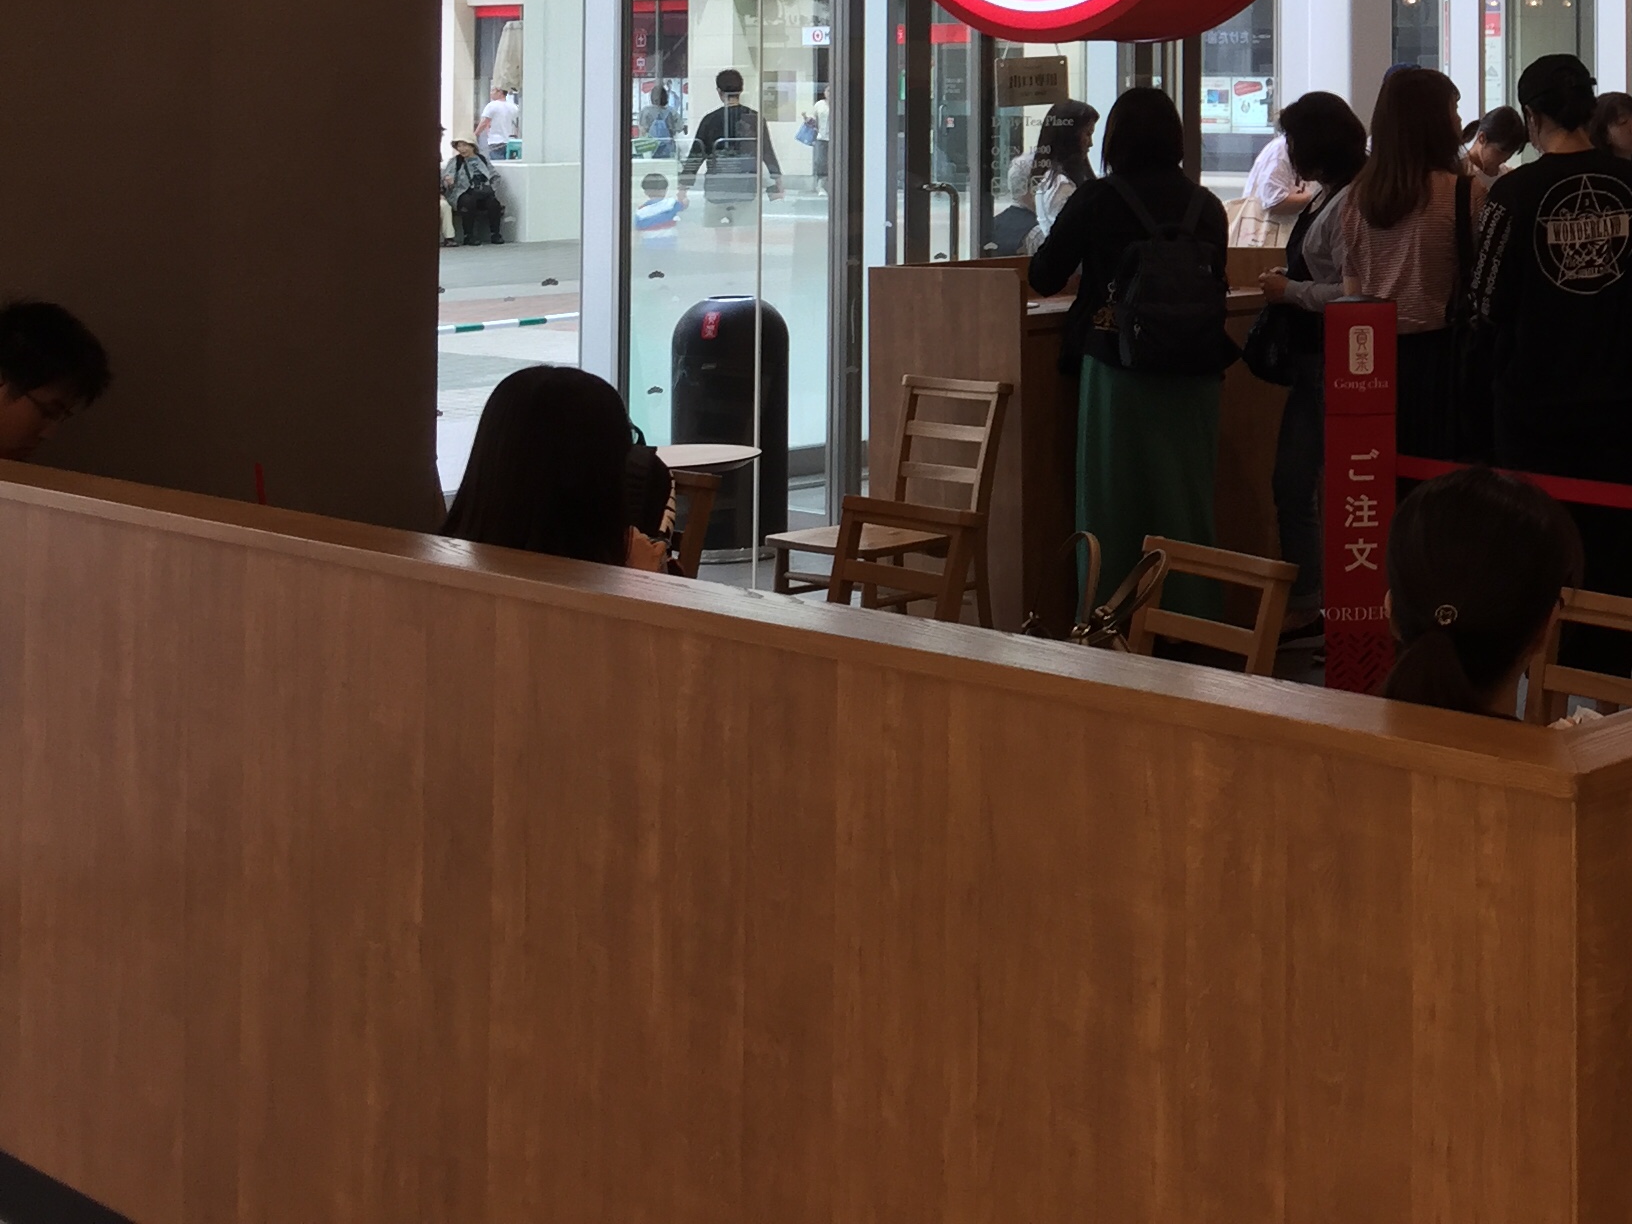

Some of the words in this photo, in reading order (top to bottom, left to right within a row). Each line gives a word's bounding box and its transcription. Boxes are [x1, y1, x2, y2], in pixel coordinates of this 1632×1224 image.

[1025, 116, 1045, 127] Tea
[1047, 115, 1075, 127] Place
[991, 145, 1021, 156] OEN
[1552, 216, 1622, 242] WONDERLAND
[1334, 378, 1367, 392] Gong
[1367, 376, 1389, 390] cha
[1344, 449, 1379, 572] ご注文
